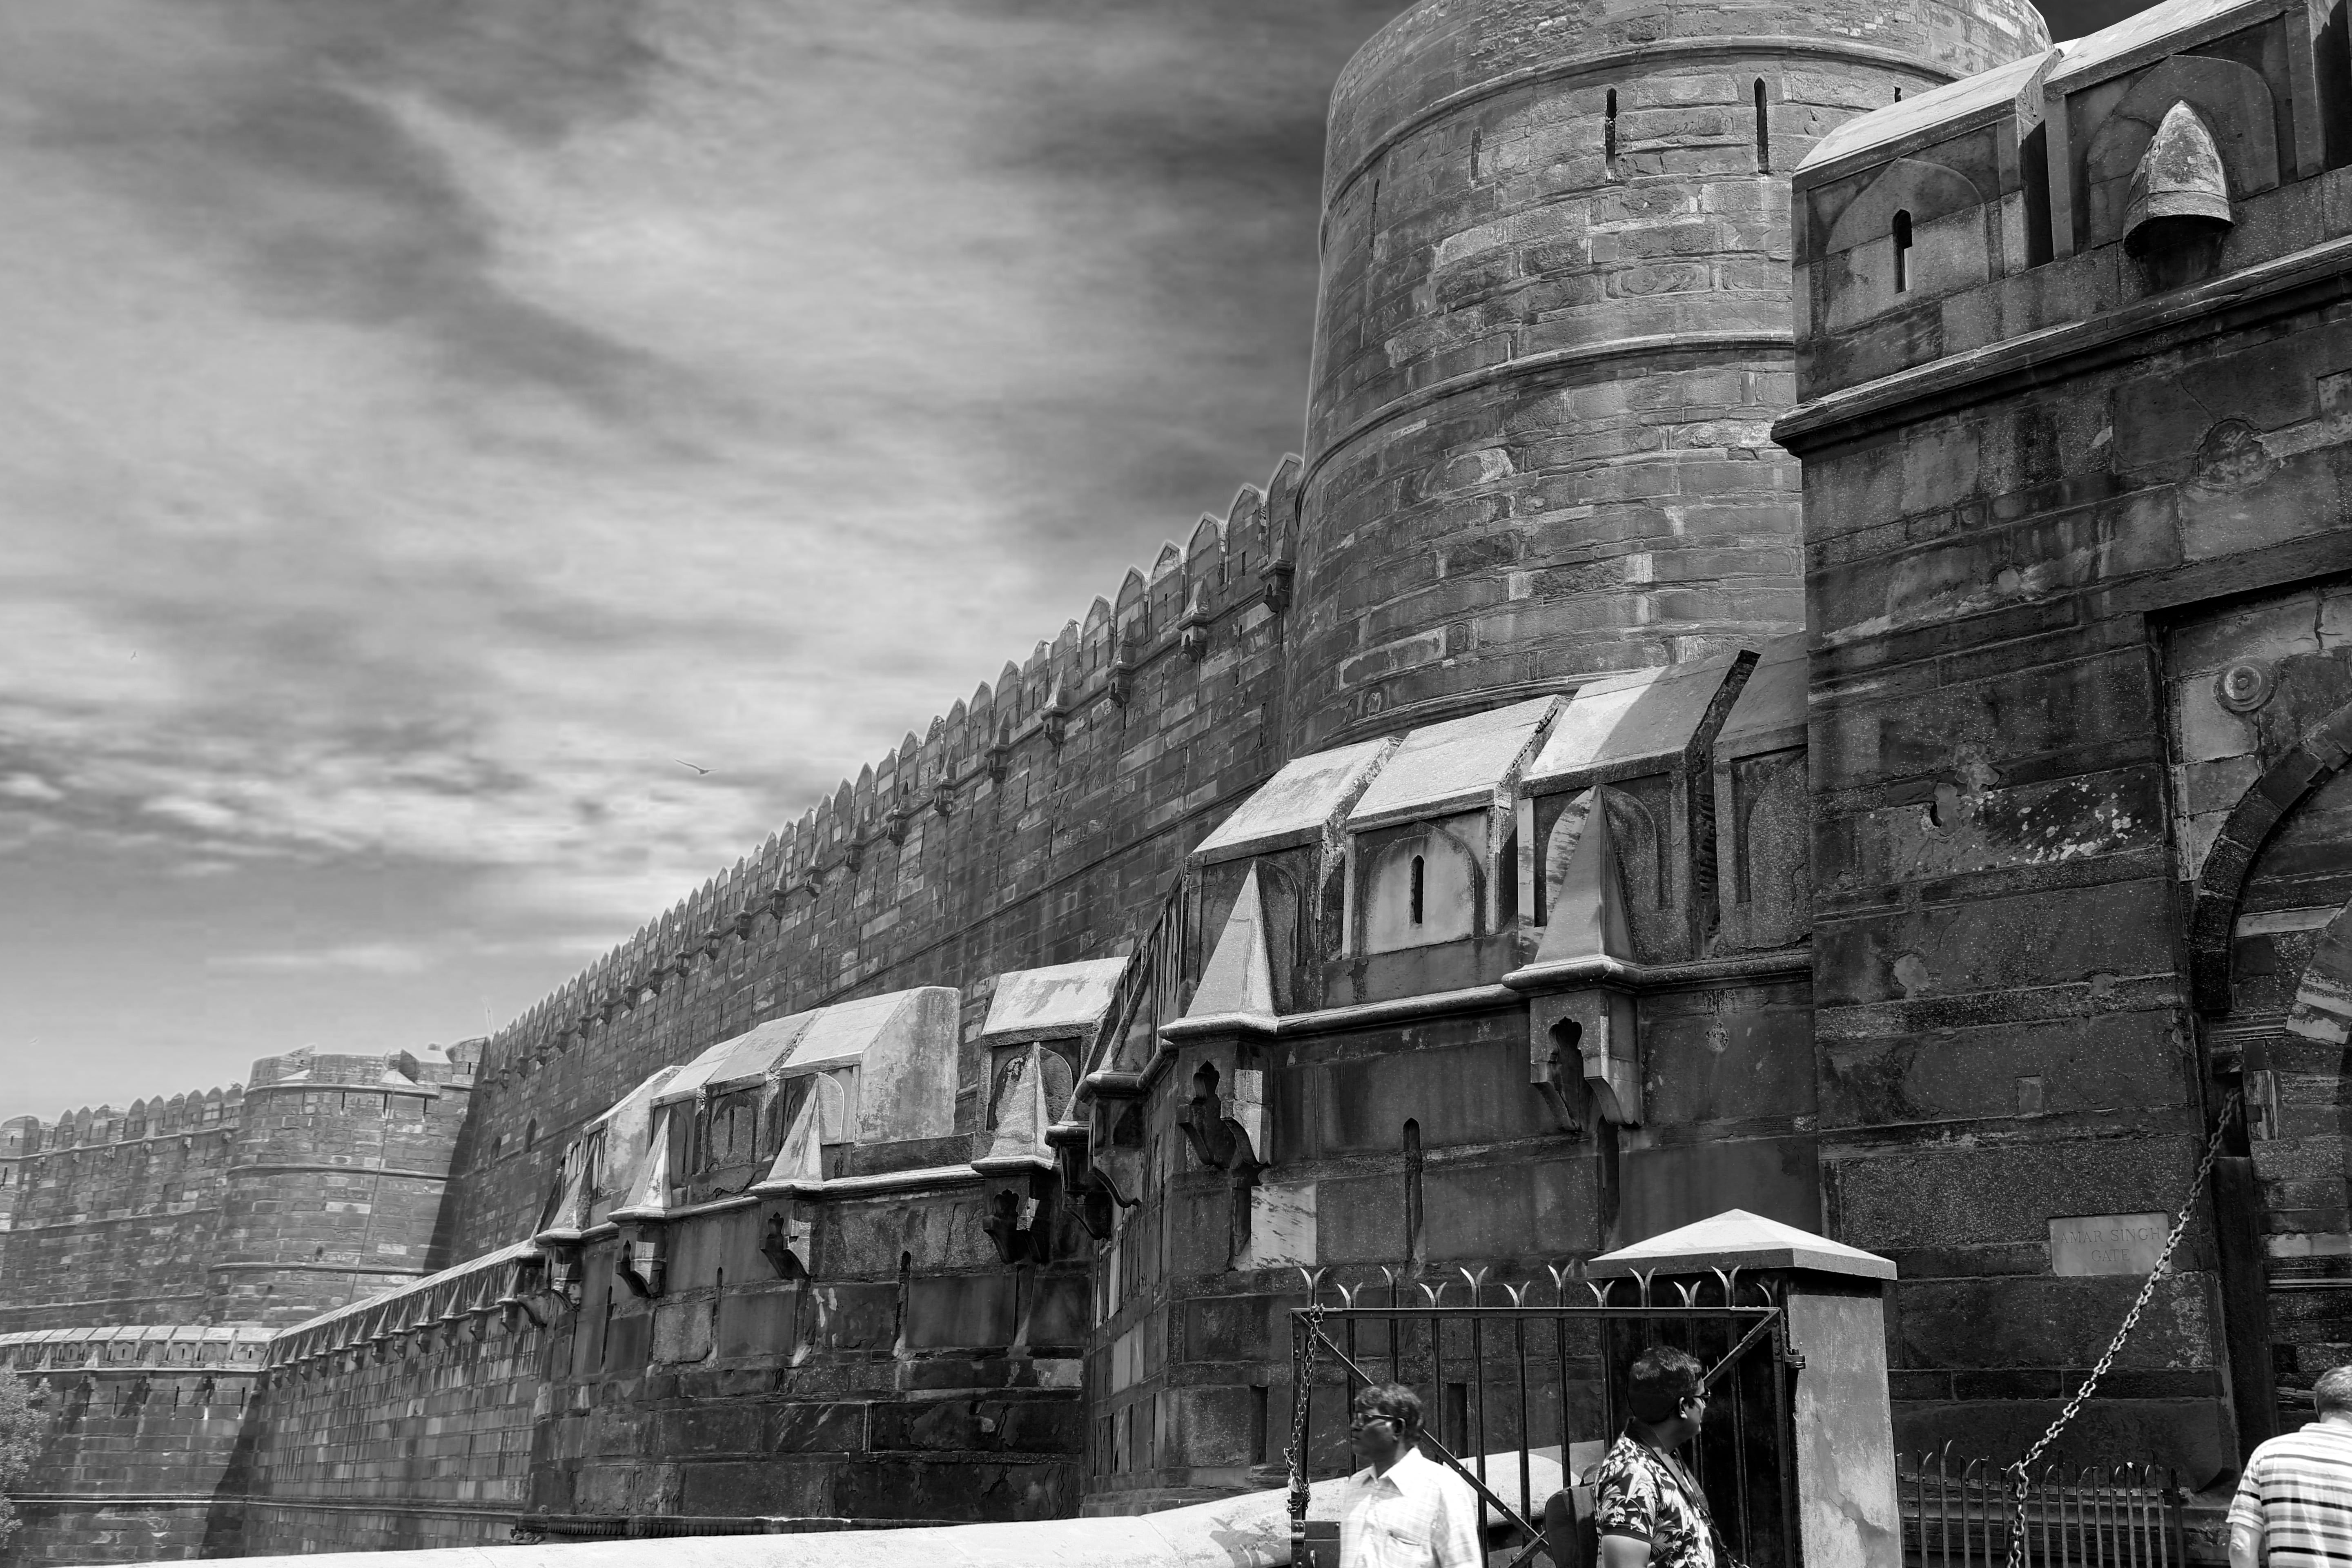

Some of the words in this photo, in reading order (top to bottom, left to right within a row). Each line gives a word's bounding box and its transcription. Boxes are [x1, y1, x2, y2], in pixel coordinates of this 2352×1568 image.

[2060, 1230, 2104, 1244] AMAR
[2110, 1227, 2161, 1241] SINGH
[2091, 1248, 2130, 1262] GATE
